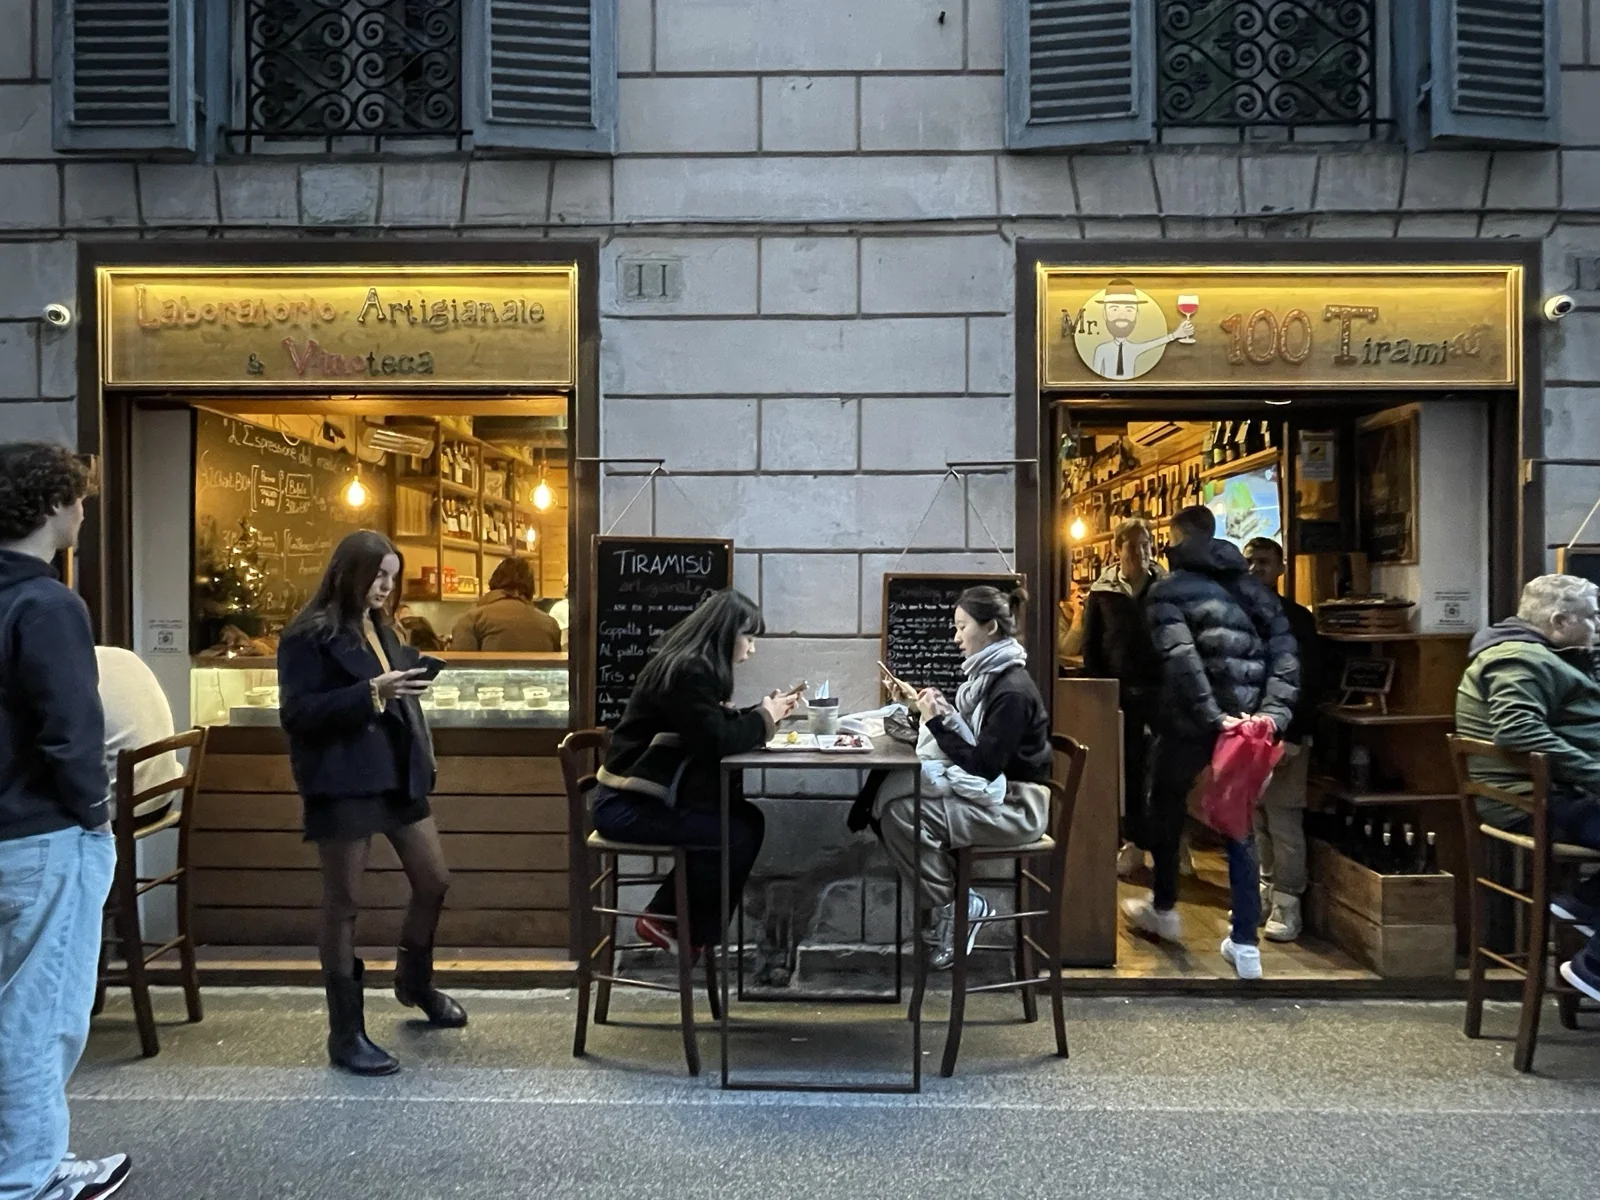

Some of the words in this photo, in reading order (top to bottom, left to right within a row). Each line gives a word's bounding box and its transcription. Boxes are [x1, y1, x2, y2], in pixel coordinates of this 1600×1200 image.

[135, 283, 336, 329] Laboratorio
[357, 286, 546, 329] Artigianale
[246, 352, 266, 376] &
[281, 336, 434, 376] Vinoteca
[1060, 308, 1100, 338] Mr.
[1220, 307, 1313, 365] 100
[613, 550, 714, 576] TIRAMISÙ
[599, 664, 624, 682] Tris
